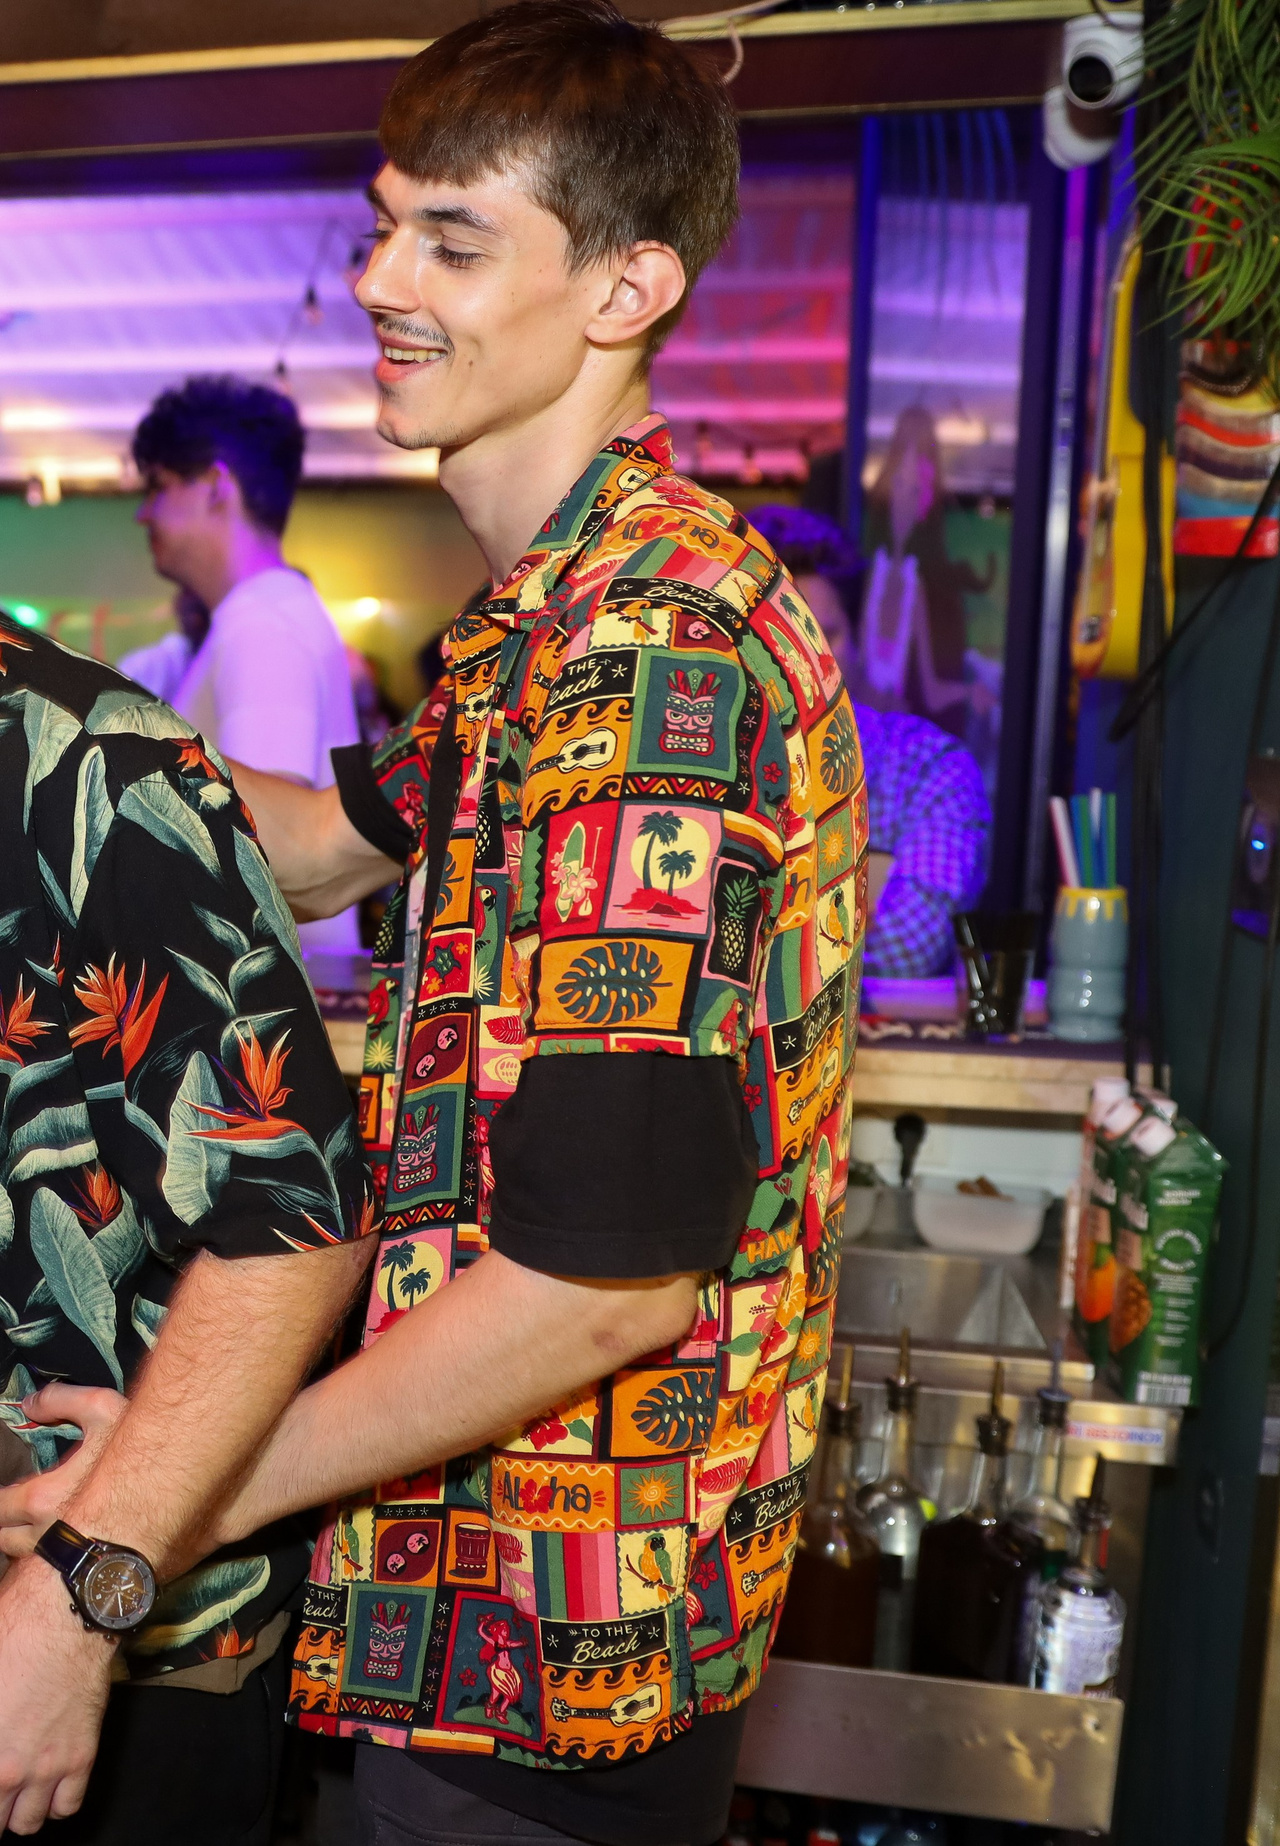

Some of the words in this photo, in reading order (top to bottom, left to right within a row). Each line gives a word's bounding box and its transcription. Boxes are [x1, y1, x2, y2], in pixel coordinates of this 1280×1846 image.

[643, 585, 720, 614] Beach
[690, 587, 718, 601] THE
[567, 657, 597, 676] THE
[759, 1487, 775, 1501] TO
[777, 1474, 798, 1493] THE
[754, 1480, 803, 1529] Beach
[317, 1590, 336, 1602] THE
[581, 1627, 601, 1639] TO
[605, 1623, 634, 1638] THE
[571, 1630, 642, 1664] Beach
